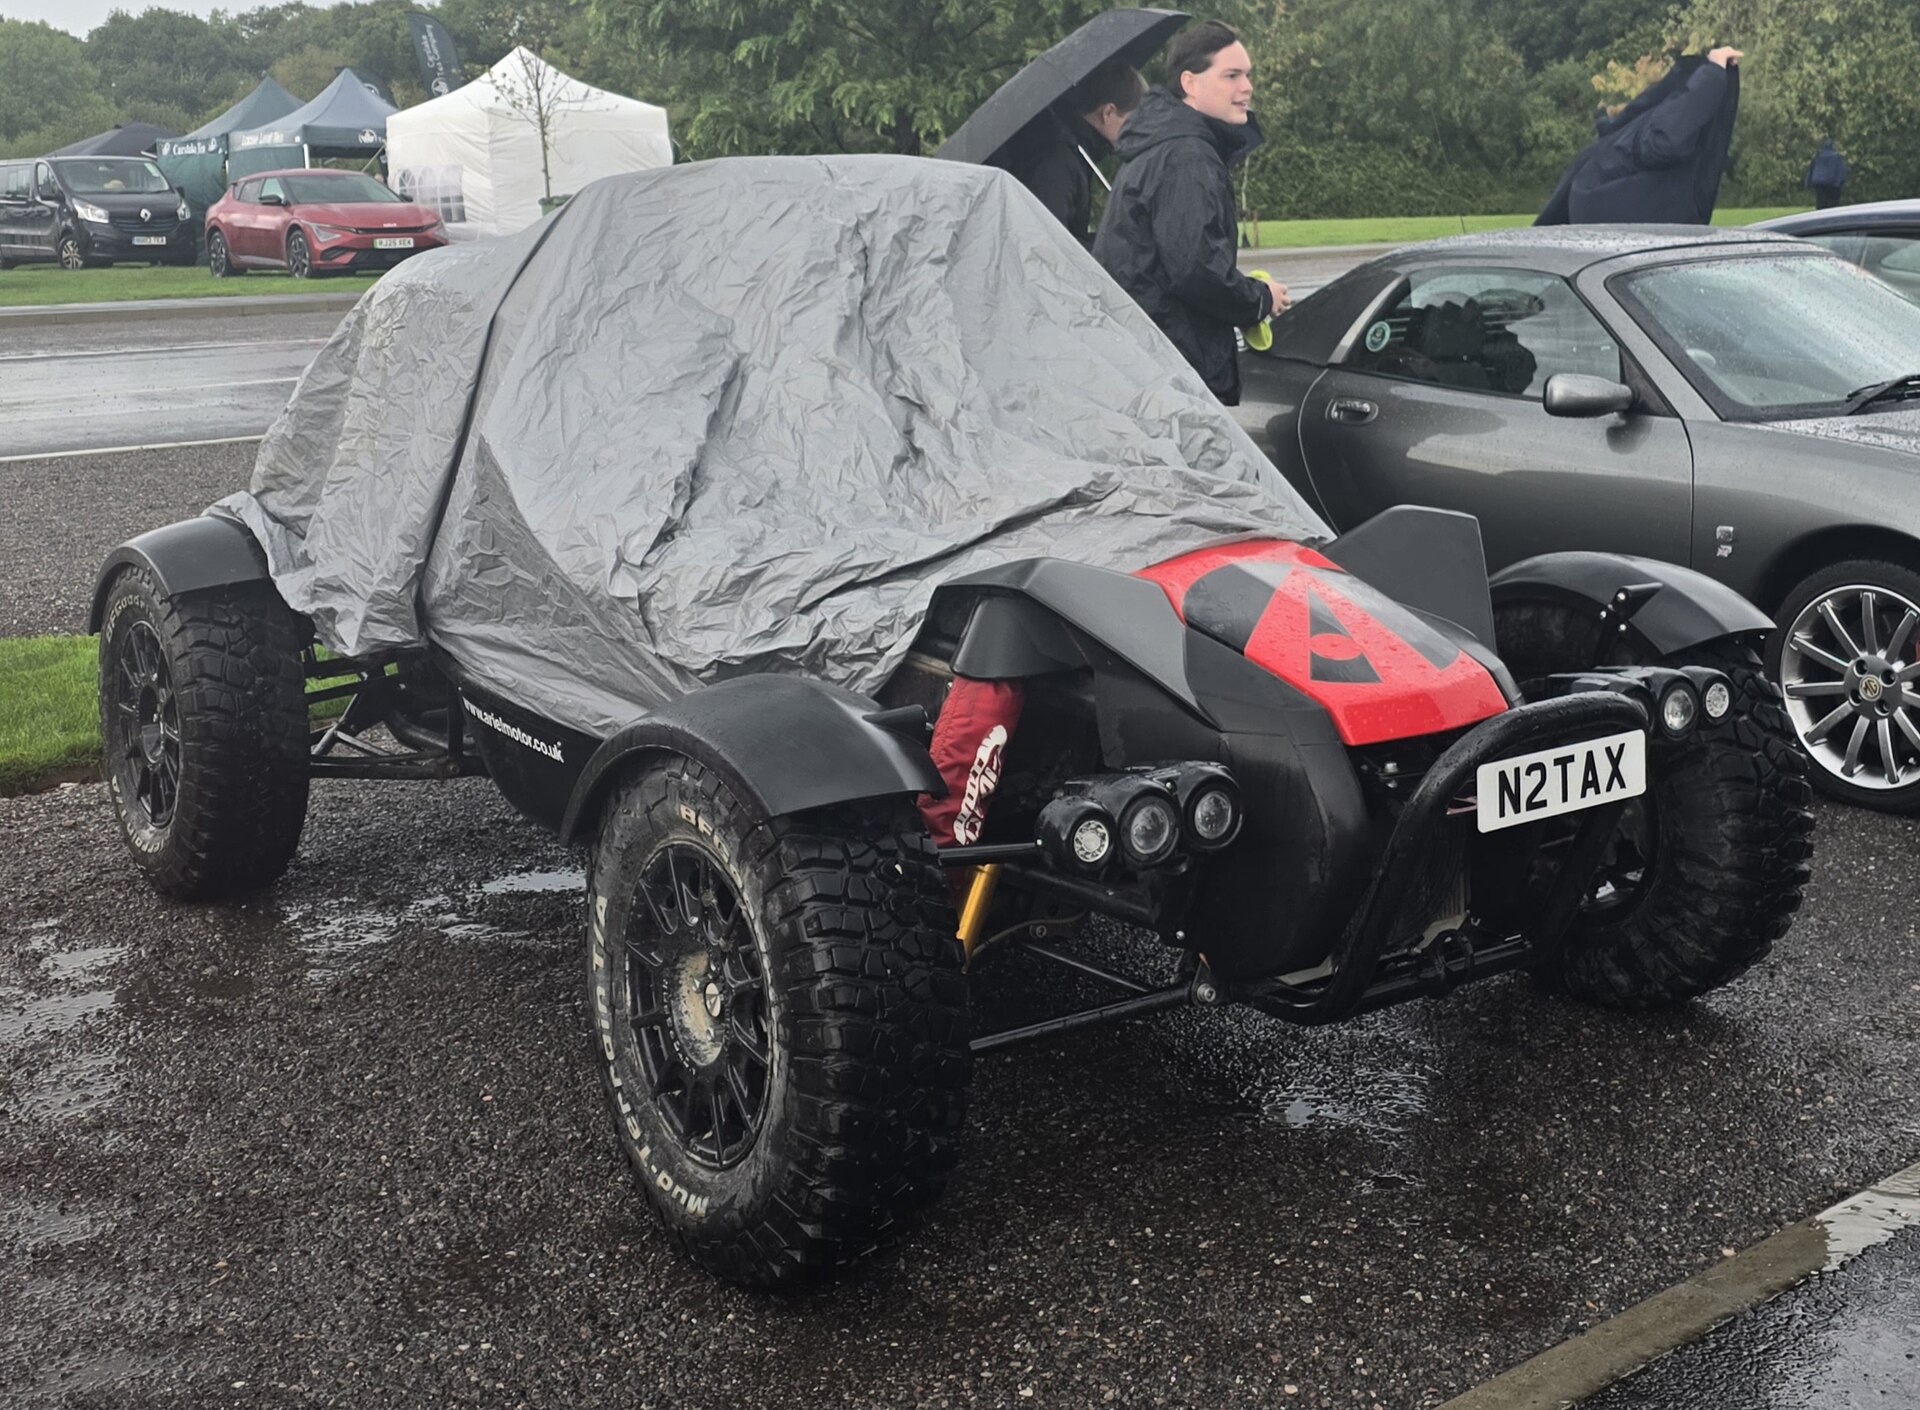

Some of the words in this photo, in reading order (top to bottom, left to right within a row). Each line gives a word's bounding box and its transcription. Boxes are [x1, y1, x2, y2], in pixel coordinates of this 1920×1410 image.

[425, 23, 440, 61] Company
[436, 62, 445, 77] Tea
[462, 696, 565, 764] www.arielmotor.co.uk
[592, 895, 608, 971] T/A
